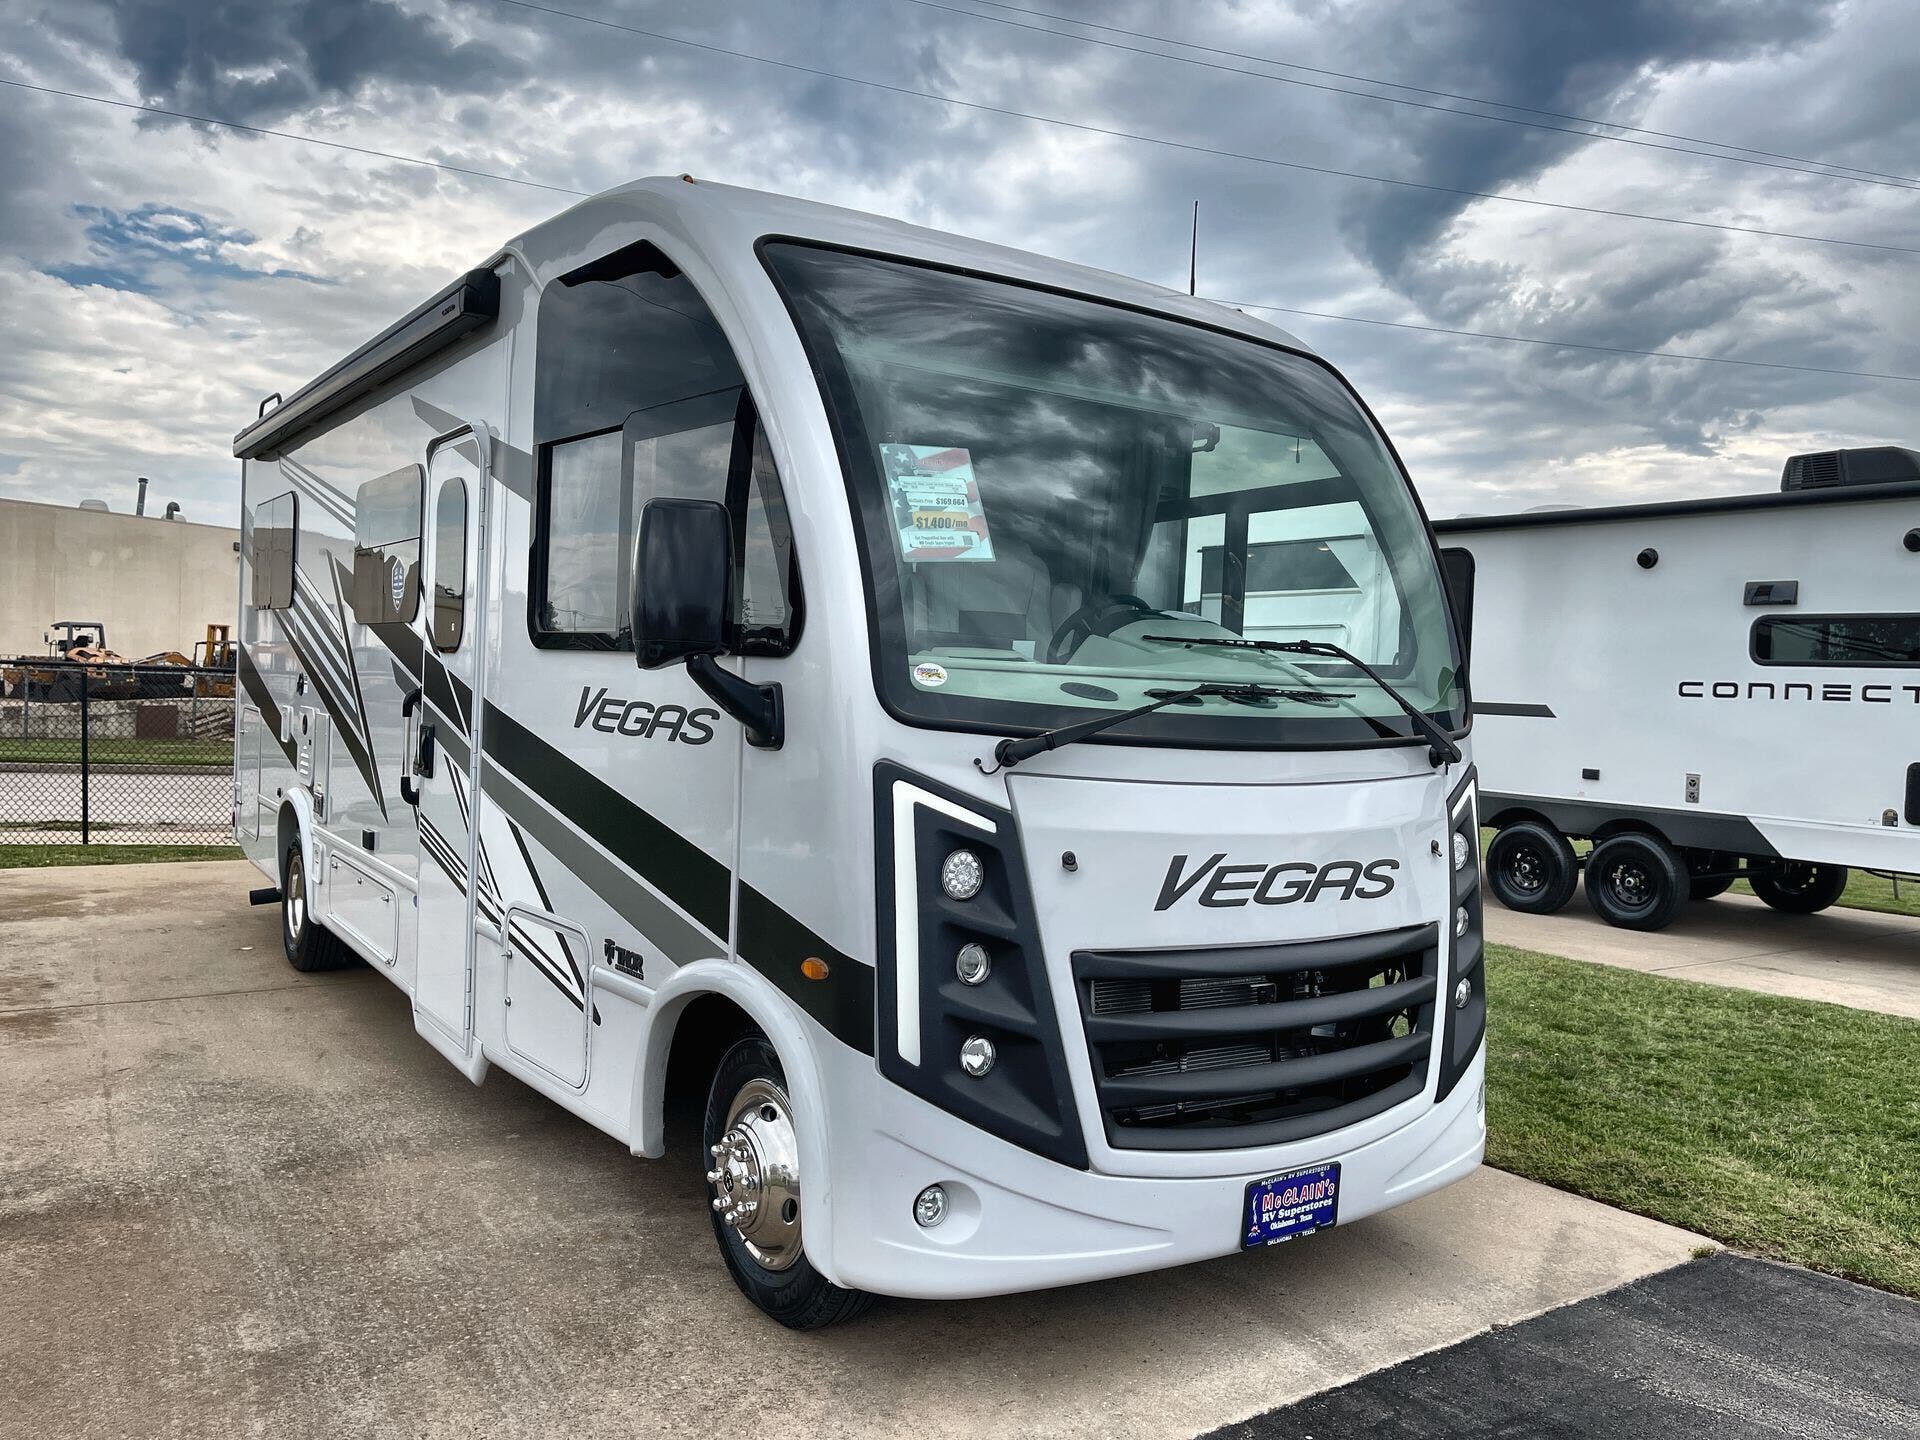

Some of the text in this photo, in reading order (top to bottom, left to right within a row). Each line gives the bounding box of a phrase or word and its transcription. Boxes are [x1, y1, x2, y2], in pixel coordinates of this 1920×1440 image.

[574, 686, 721, 745] VEGAS
[1154, 853, 1400, 912] VEGAS
[1261, 1198, 1333, 1223] RV Superstores
[1300, 1213, 1314, 1223] Texas
[1267, 1228, 1316, 1246] OKLAHOMA TEXAS
